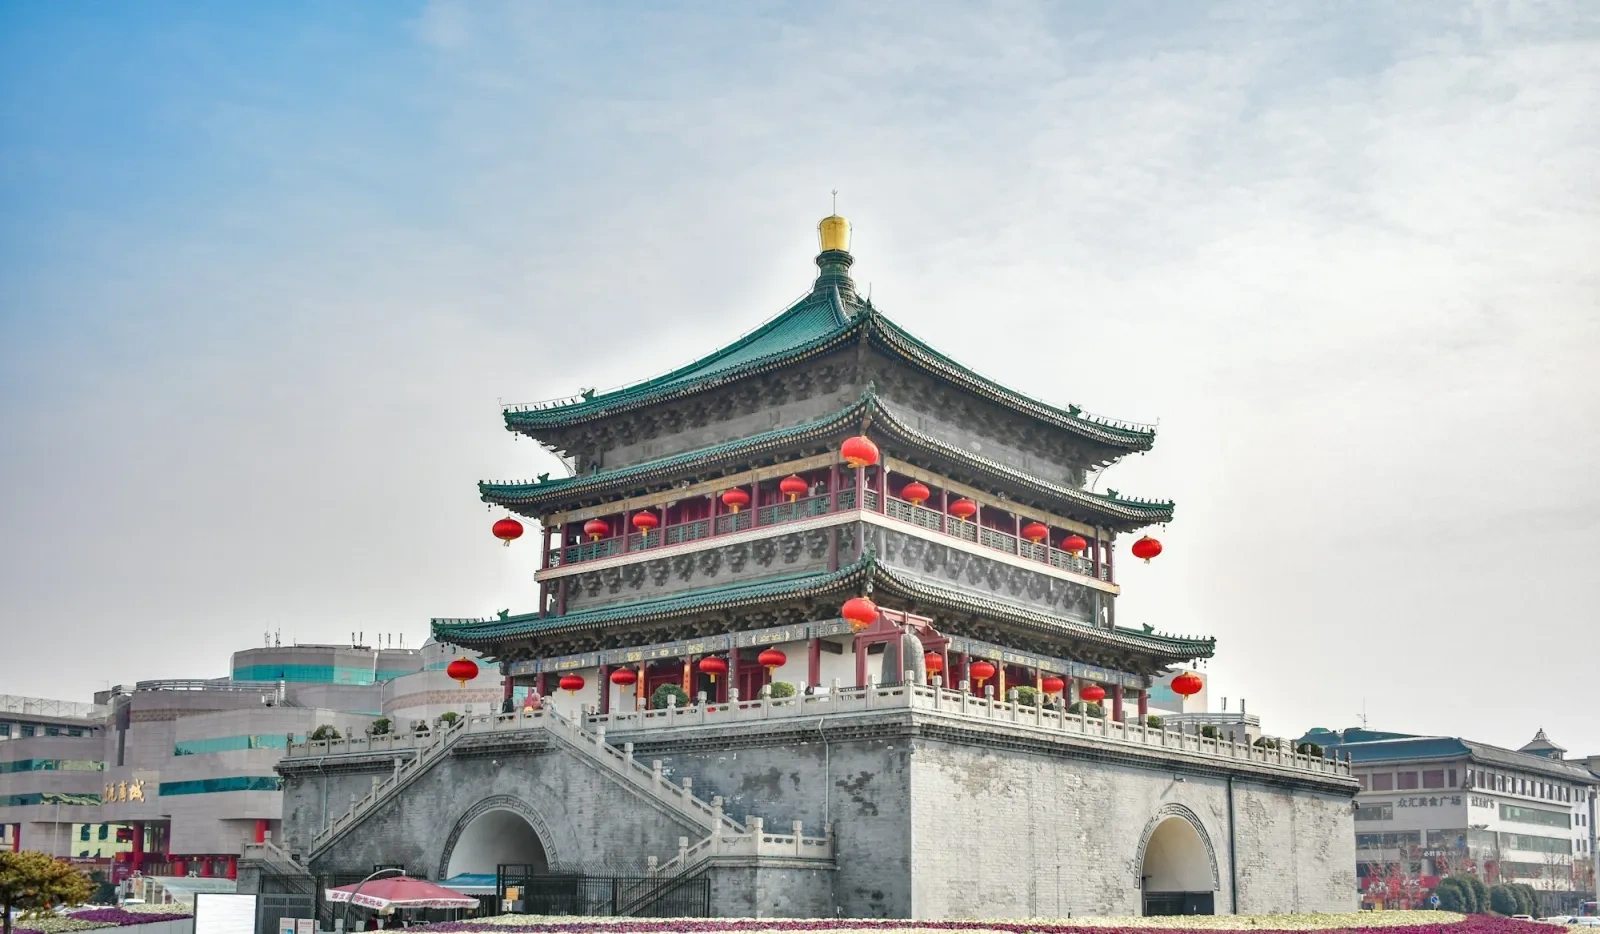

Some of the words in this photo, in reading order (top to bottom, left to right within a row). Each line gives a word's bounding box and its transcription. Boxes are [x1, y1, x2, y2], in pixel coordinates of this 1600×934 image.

[1397, 796, 1461, 808] 众汇美食广场
